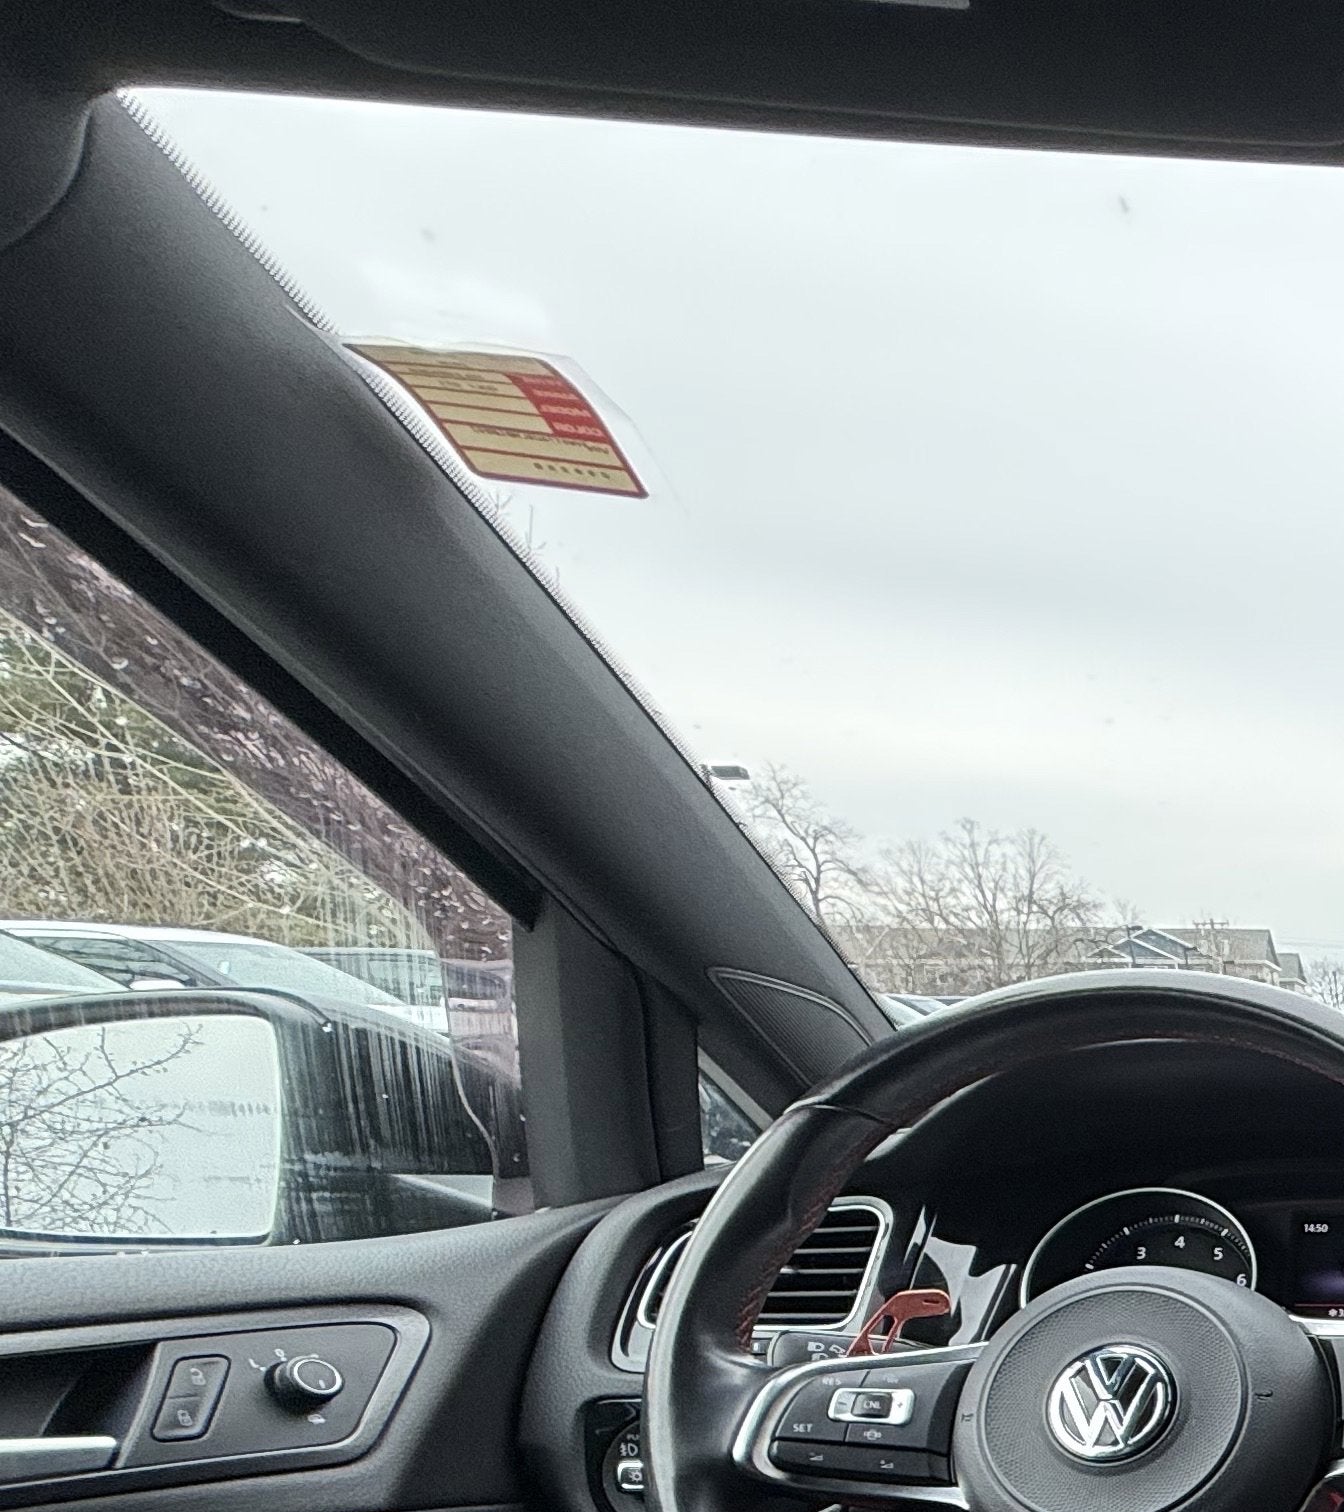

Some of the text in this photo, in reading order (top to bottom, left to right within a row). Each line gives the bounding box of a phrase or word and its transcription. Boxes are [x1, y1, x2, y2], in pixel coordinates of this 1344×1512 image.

[1174, 1236, 1186, 1249] 4
[1136, 1247, 1146, 1260] 3
[1214, 1247, 1224, 1260] 5
[1236, 1274, 1247, 1287] 6
[864, 1400, 881, 1410] CNL
[792, 1423, 813, 1433] SET
